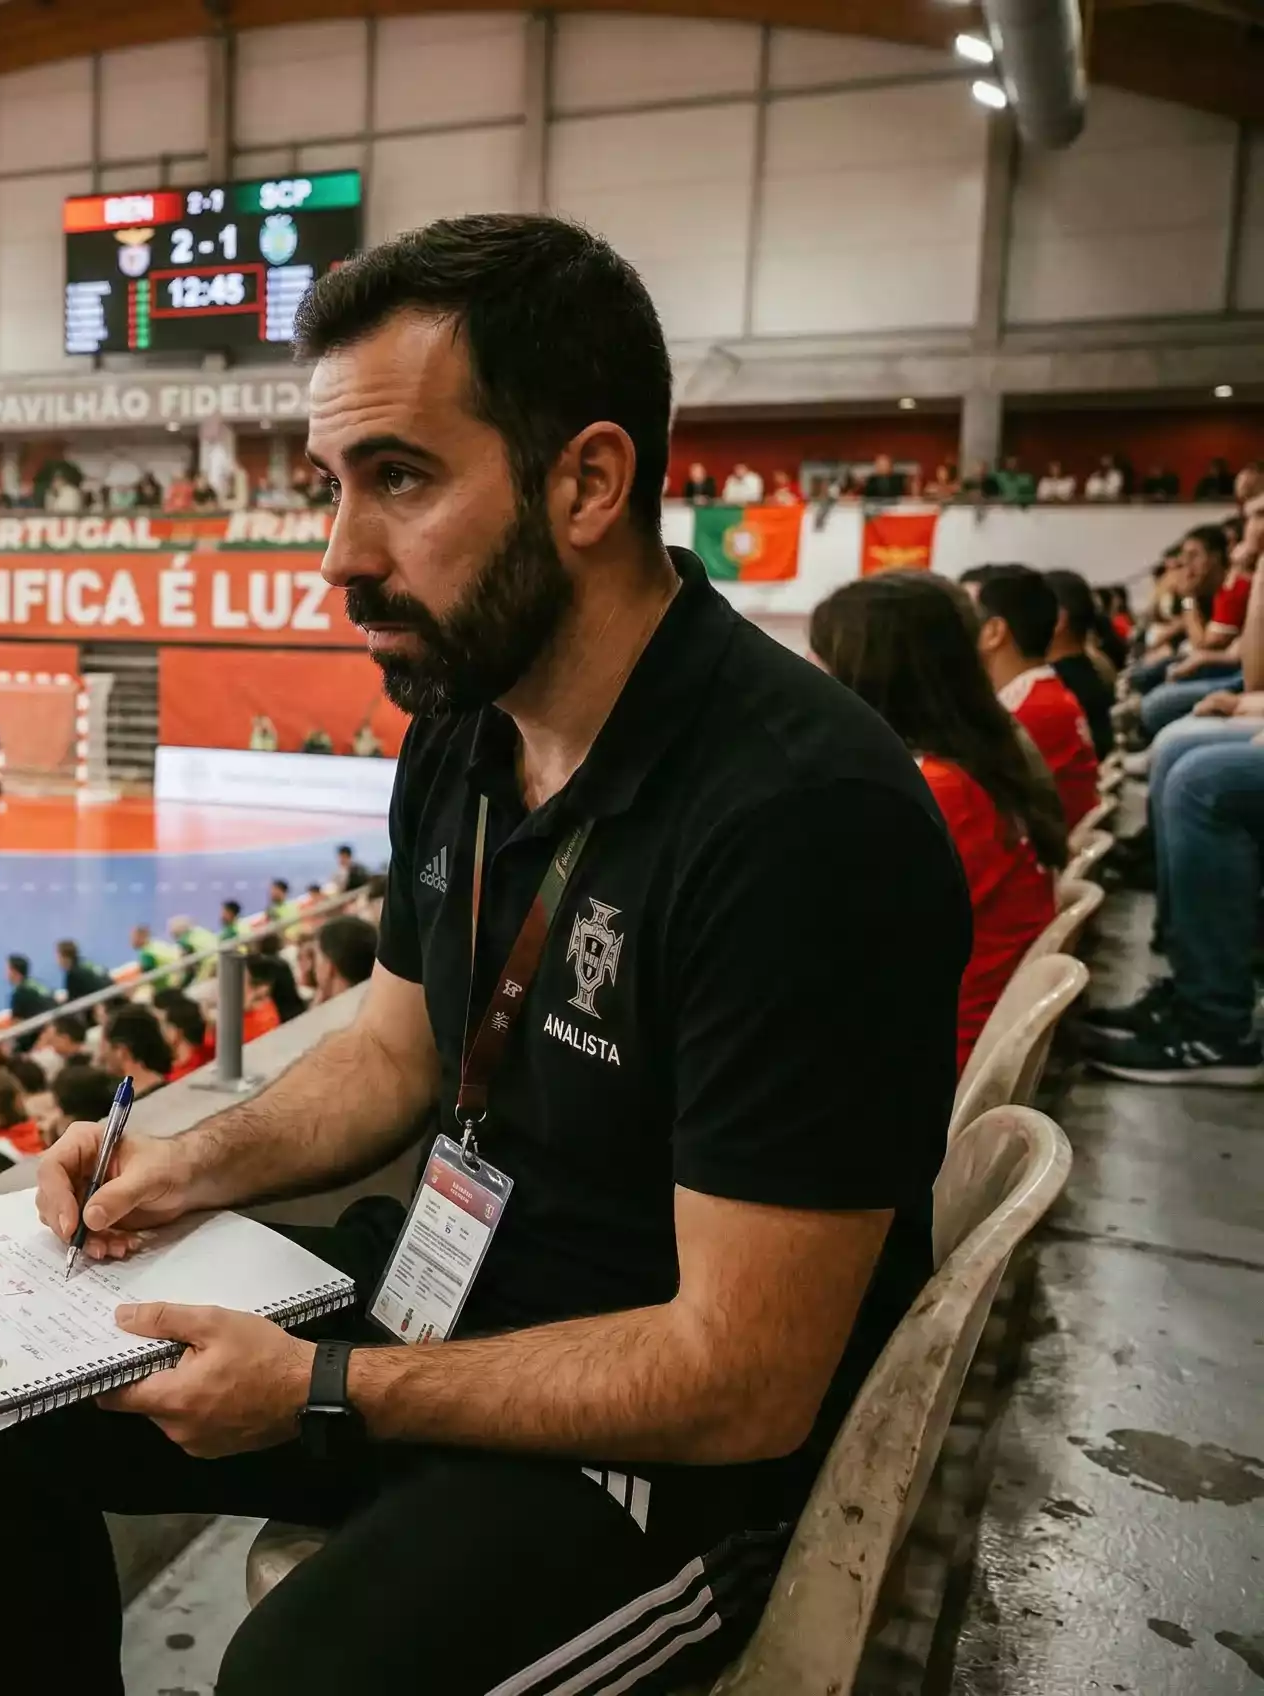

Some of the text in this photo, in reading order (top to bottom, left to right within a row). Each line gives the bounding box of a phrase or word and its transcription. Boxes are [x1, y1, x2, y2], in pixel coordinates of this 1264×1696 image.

[167, 272, 246, 308] 12:45
[159, 552, 197, 628] É
[212, 570, 332, 631] LUZ
[543, 1012, 621, 1066] ANALISTA
